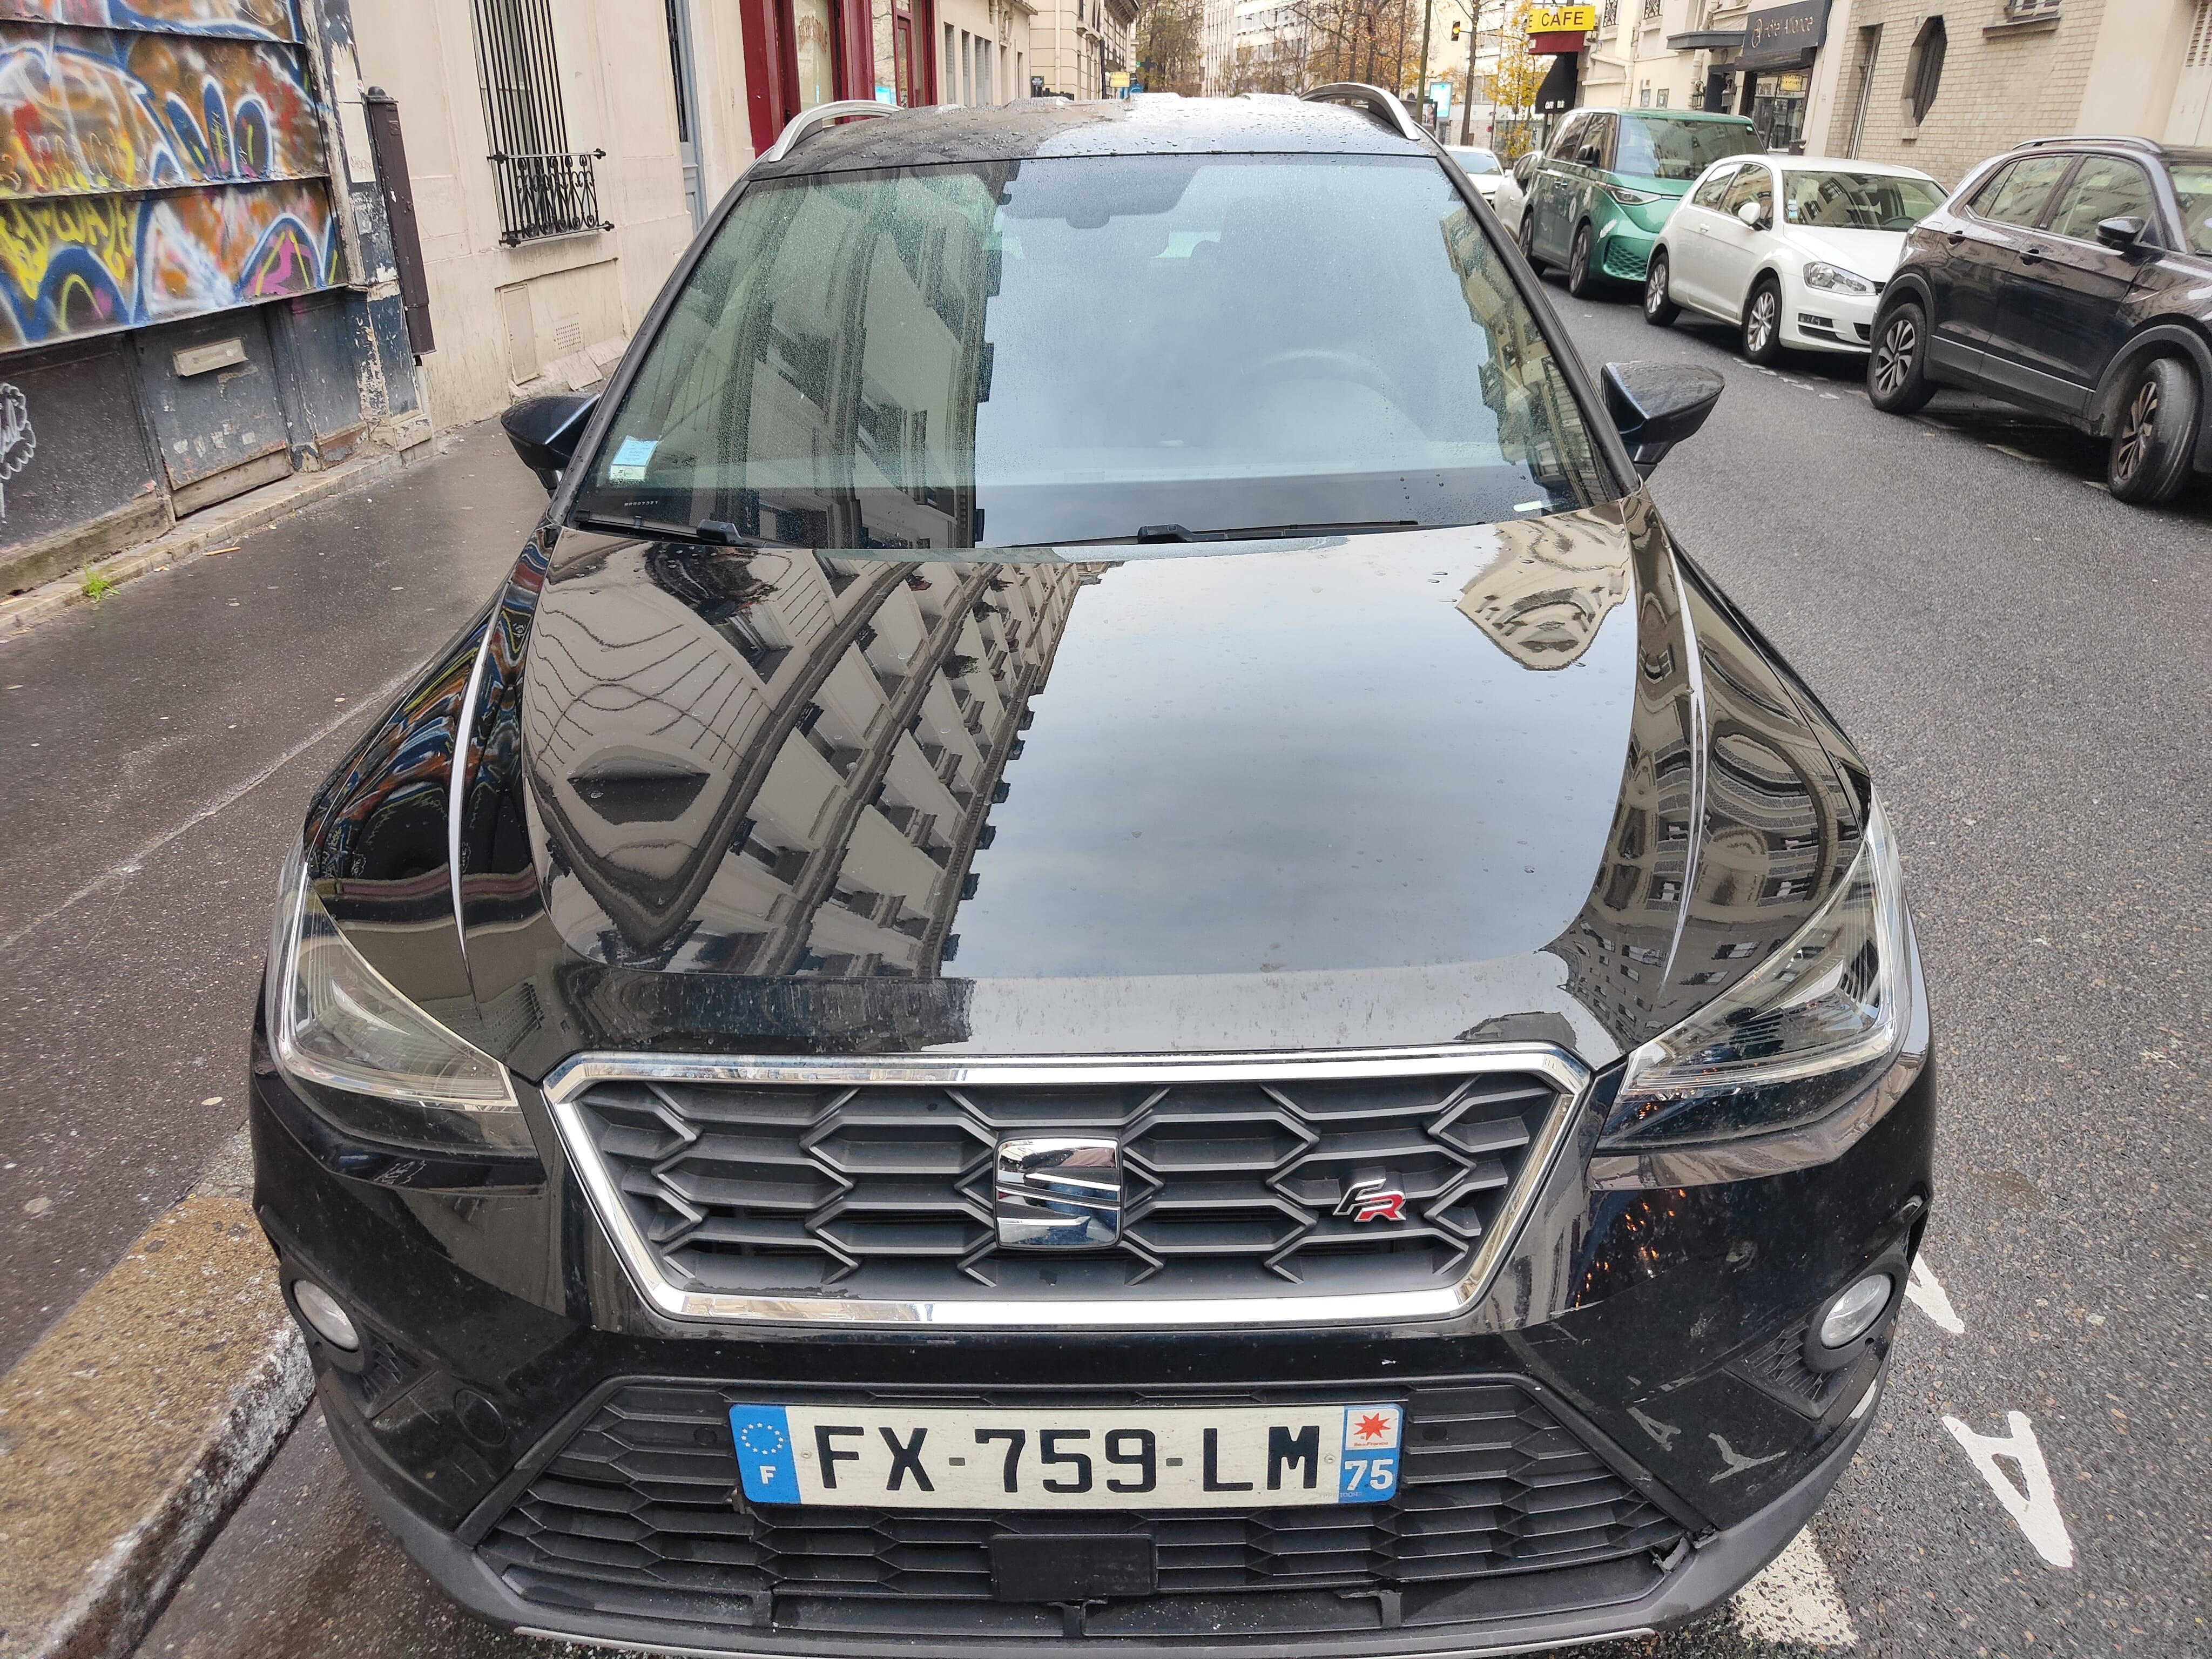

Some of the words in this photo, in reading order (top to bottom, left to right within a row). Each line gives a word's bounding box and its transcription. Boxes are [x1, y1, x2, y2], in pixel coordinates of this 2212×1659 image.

[1332, 1178, 1407, 1222] FR
[759, 1465, 777, 1485] F
[814, 1425, 1320, 1494] FX-759-LM
[1344, 1459, 1394, 1491] 75
